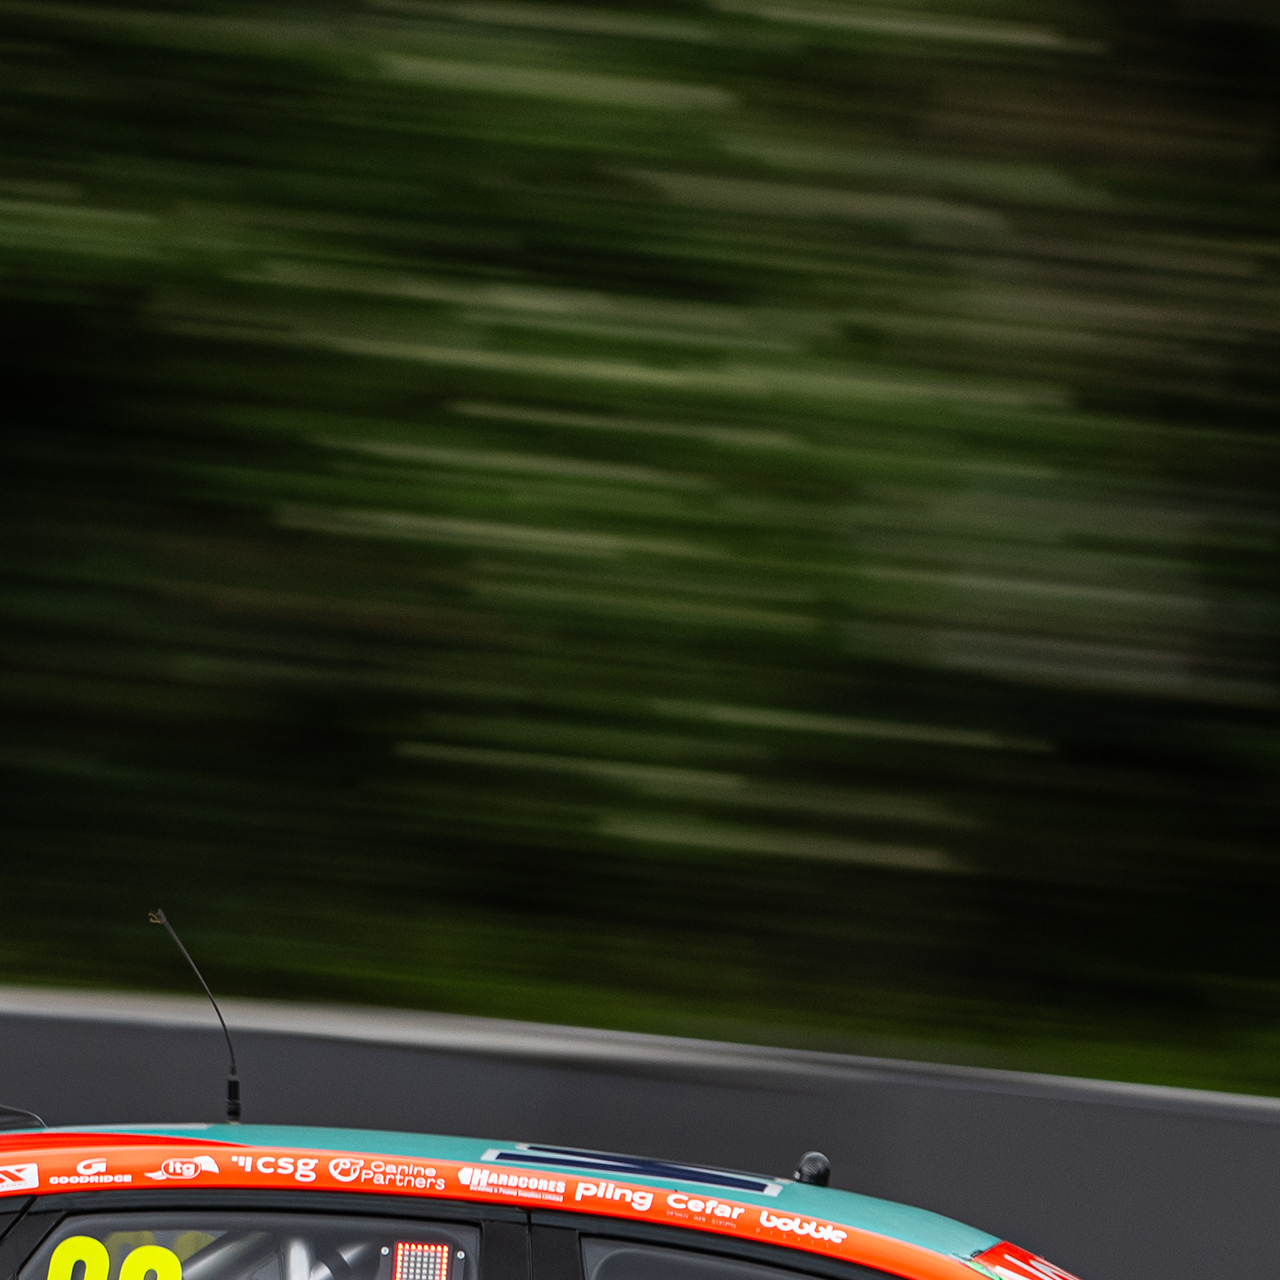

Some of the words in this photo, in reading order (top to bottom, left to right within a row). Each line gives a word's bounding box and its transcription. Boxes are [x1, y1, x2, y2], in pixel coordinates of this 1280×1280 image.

[49, 1174, 132, 1185] GOODRIDGE
[257, 1156, 318, 1182] csg
[361, 1170, 445, 1191] Partners
[575, 1182, 654, 1212] pling
[666, 1193, 746, 1220] Cefar
[760, 1211, 848, 1244] bobble
